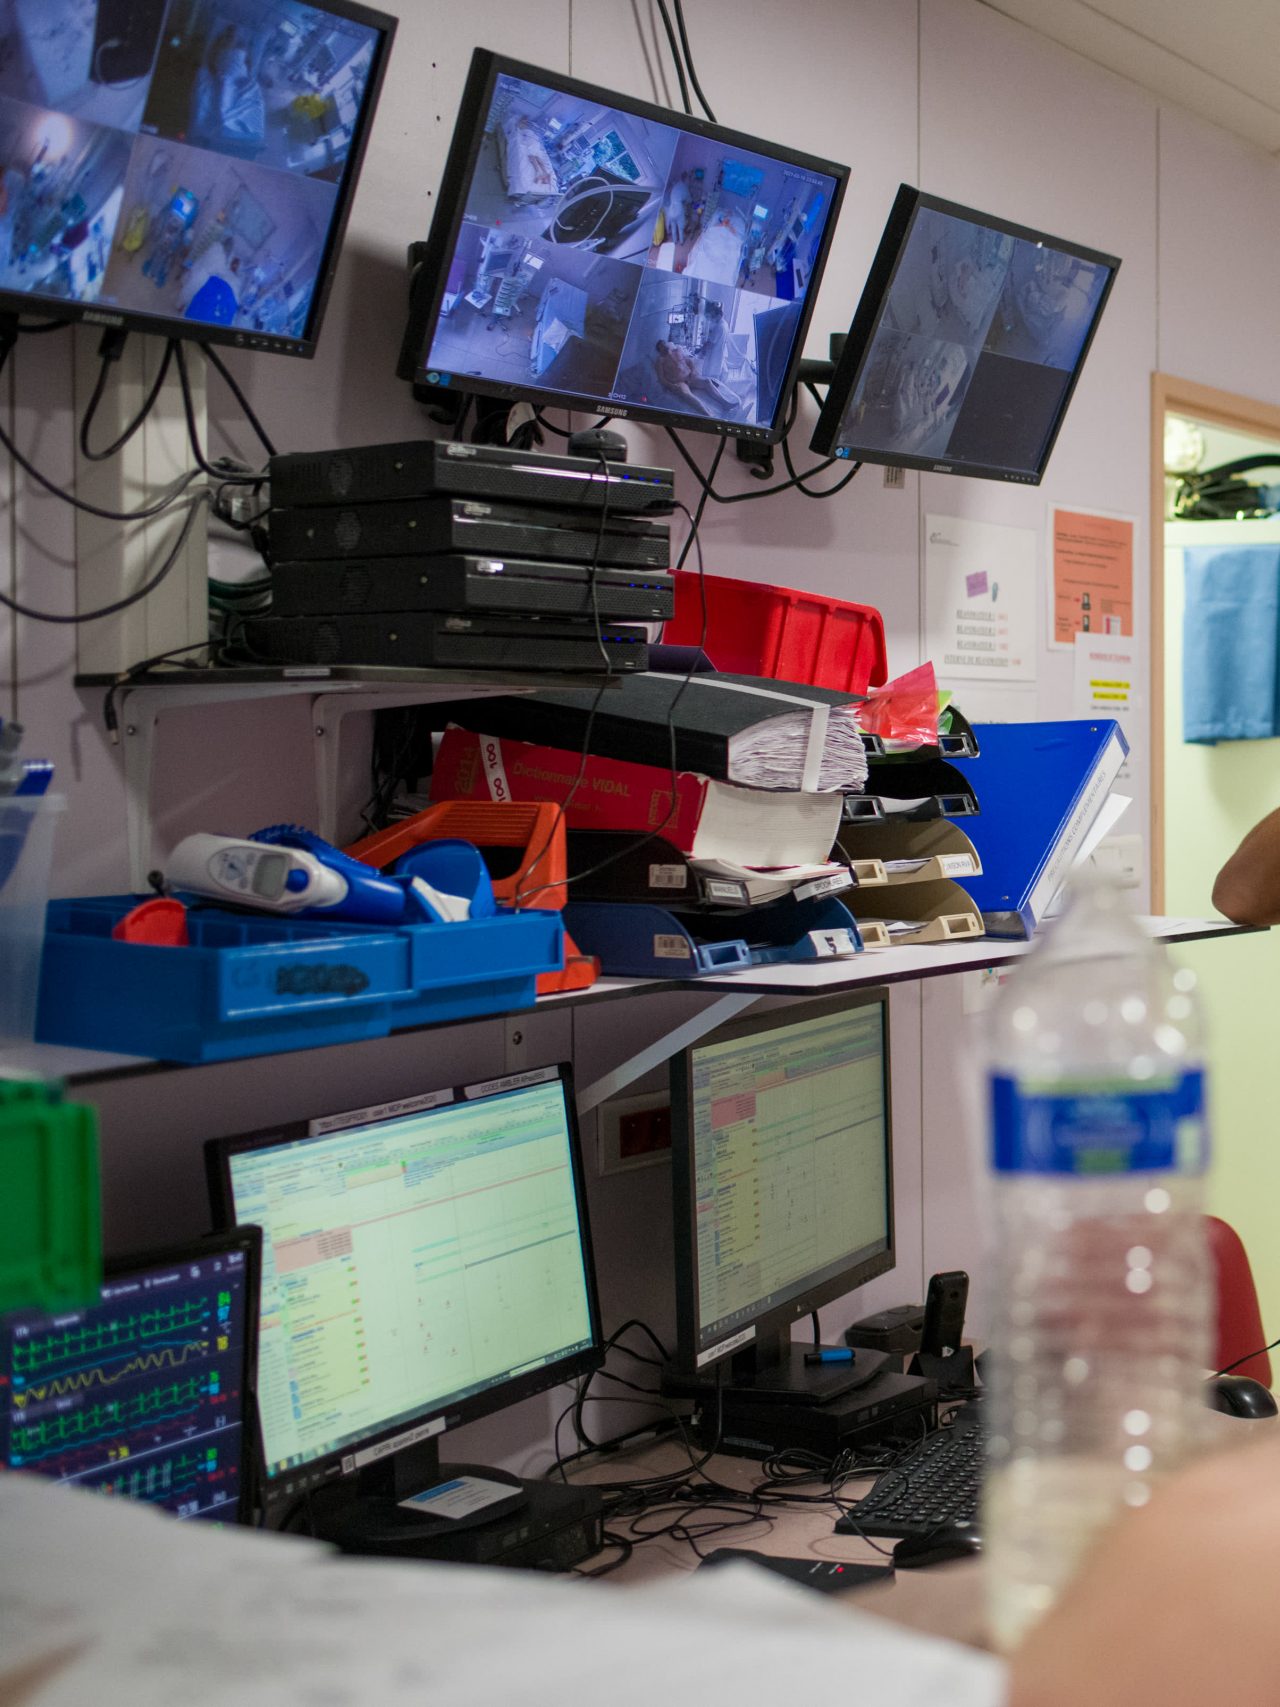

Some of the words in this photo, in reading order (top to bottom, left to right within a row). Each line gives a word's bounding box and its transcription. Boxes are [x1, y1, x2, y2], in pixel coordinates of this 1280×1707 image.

[596, 405, 628, 417] SAMSUNG
[511, 762, 588, 789] Dictionnaire
[592, 778, 632, 797] VIDAL
